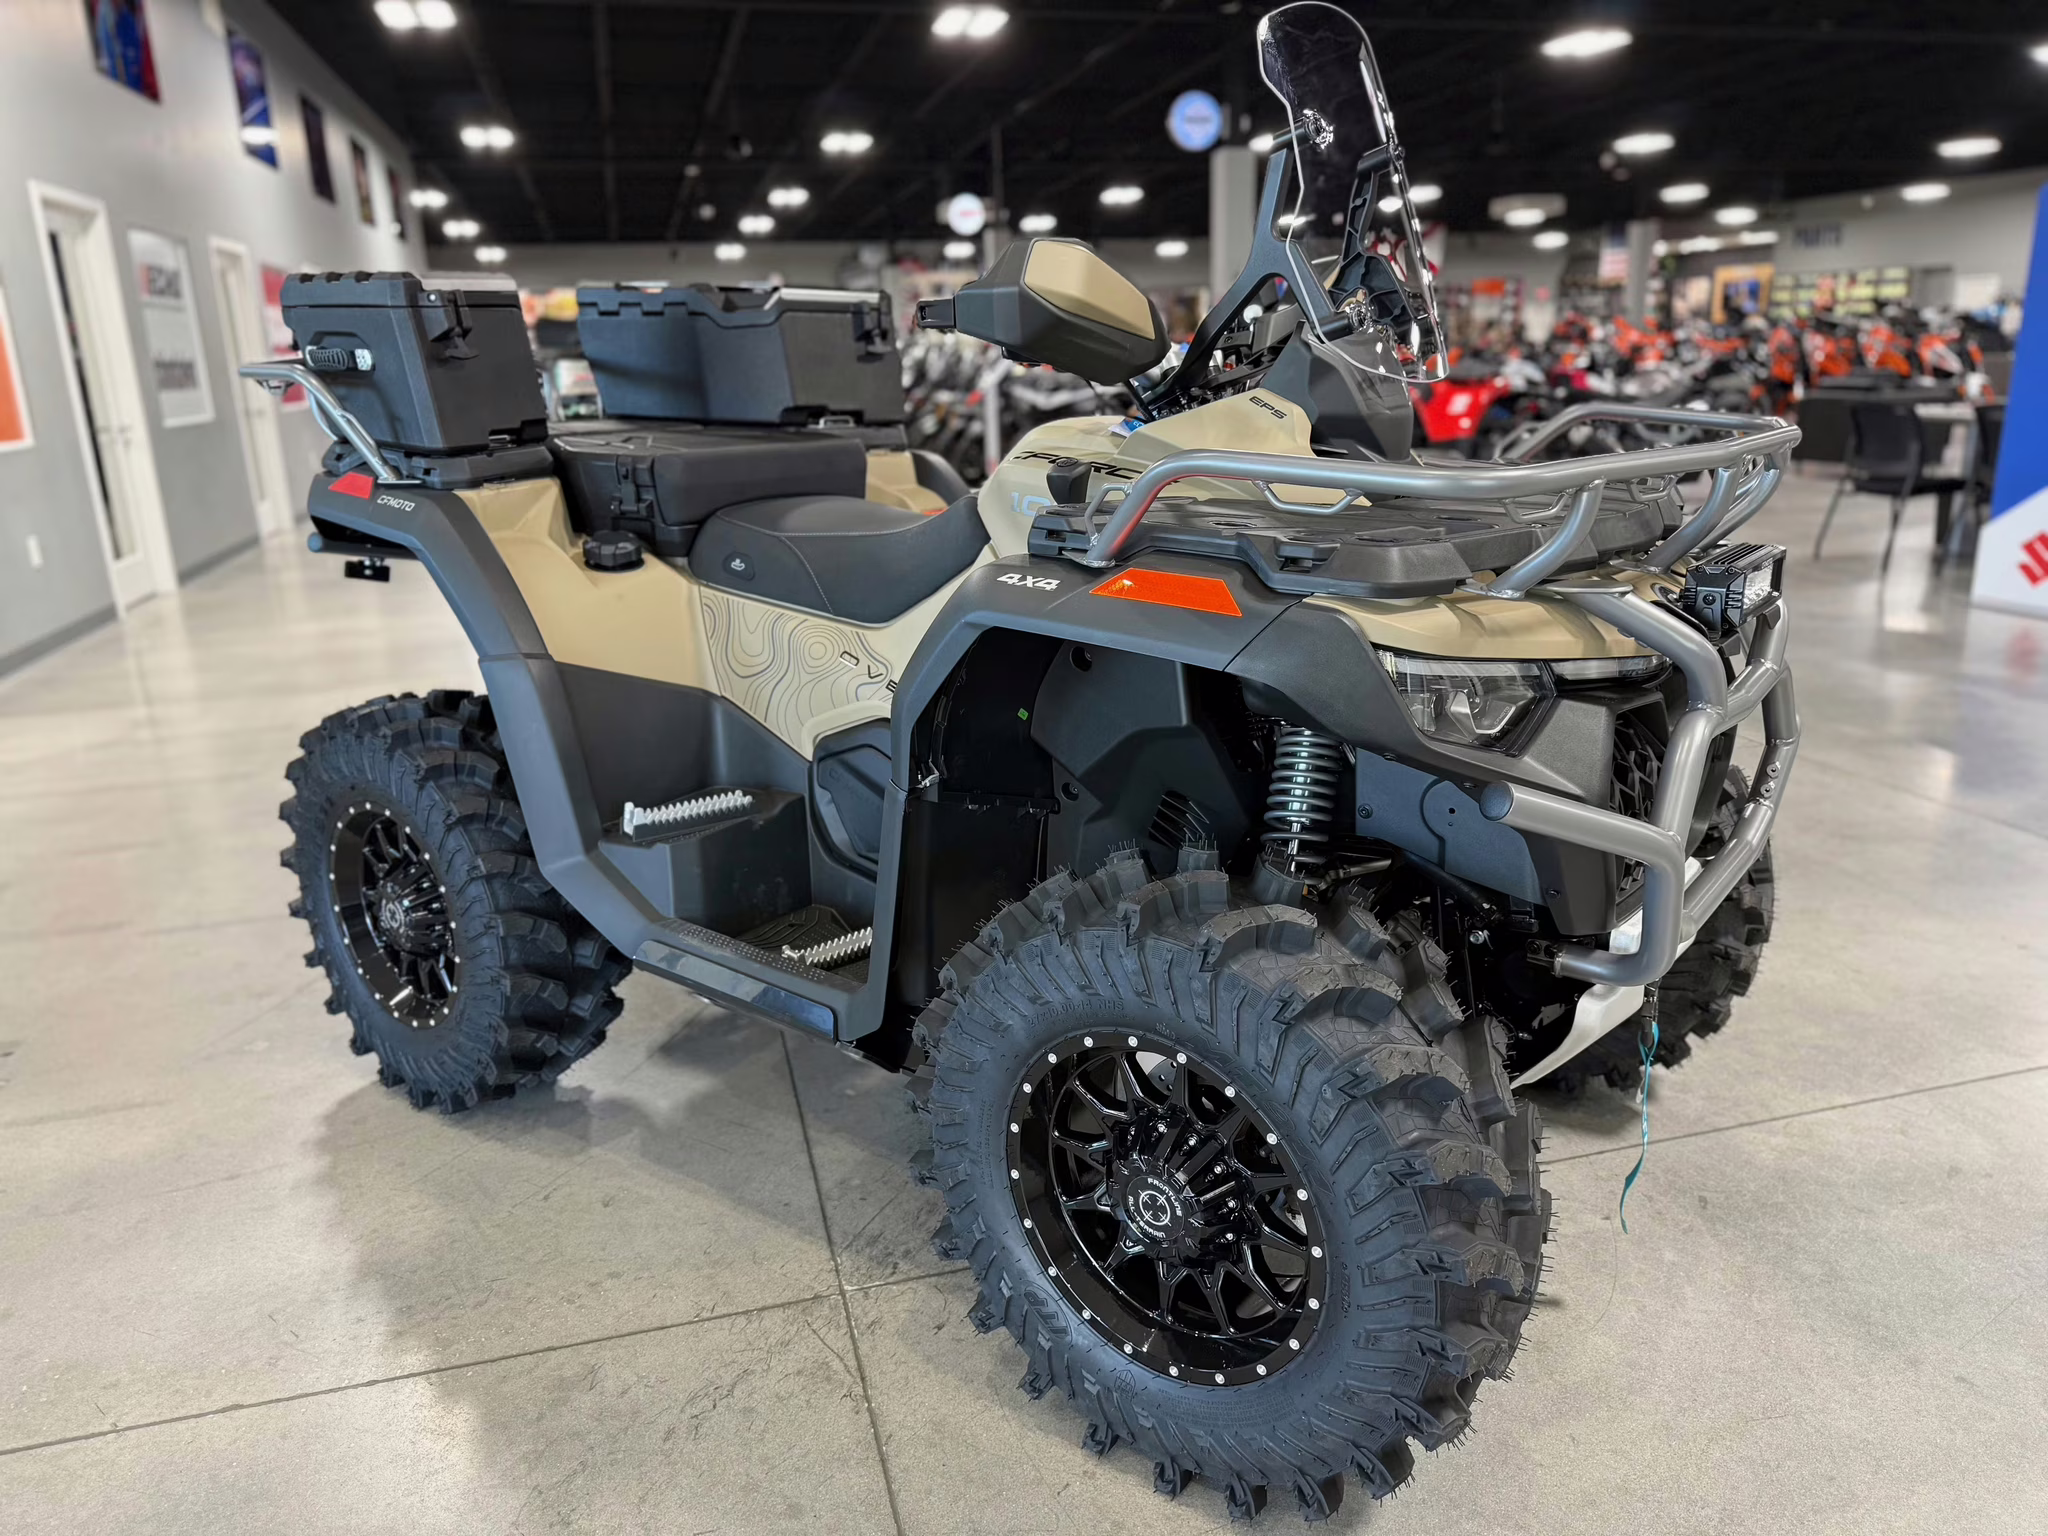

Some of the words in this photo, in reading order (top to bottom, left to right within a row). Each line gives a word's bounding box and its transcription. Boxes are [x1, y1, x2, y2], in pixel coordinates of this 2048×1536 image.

[1249, 395, 1288, 420] EPS
[1012, 451, 1144, 480] CFRC
[377, 495, 416, 511] CFMOTO
[1097, 998, 1125, 1011] NHS
[1147, 1177, 1183, 1217] FRONTLINE
[1128, 1195, 1166, 1238] ALL-TERRAIN
[1023, 1286, 1069, 1337] ITP
